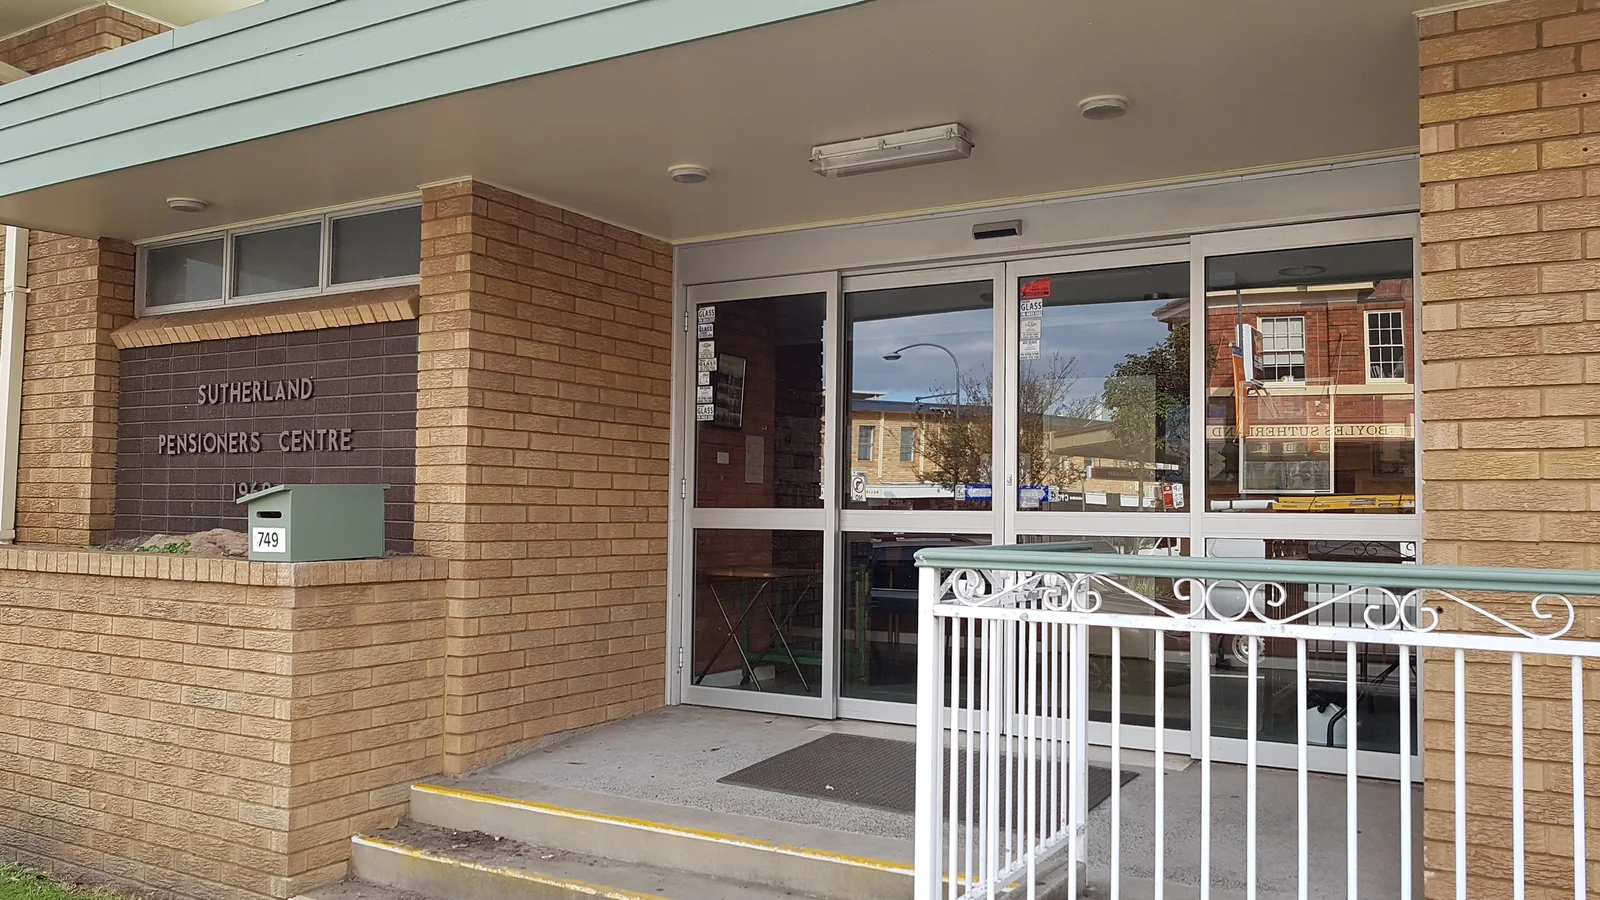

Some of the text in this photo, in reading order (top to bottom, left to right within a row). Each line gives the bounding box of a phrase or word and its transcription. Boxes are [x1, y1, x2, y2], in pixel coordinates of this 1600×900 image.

[1021, 302, 1042, 311] GLASS
[699, 309, 715, 318] GLASS
[197, 378, 314, 405] SUTHERLAND
[697, 407, 714, 415] GLASS
[158, 428, 352, 455] PENSIONERS CENTRE
[257, 531, 279, 548] 749
